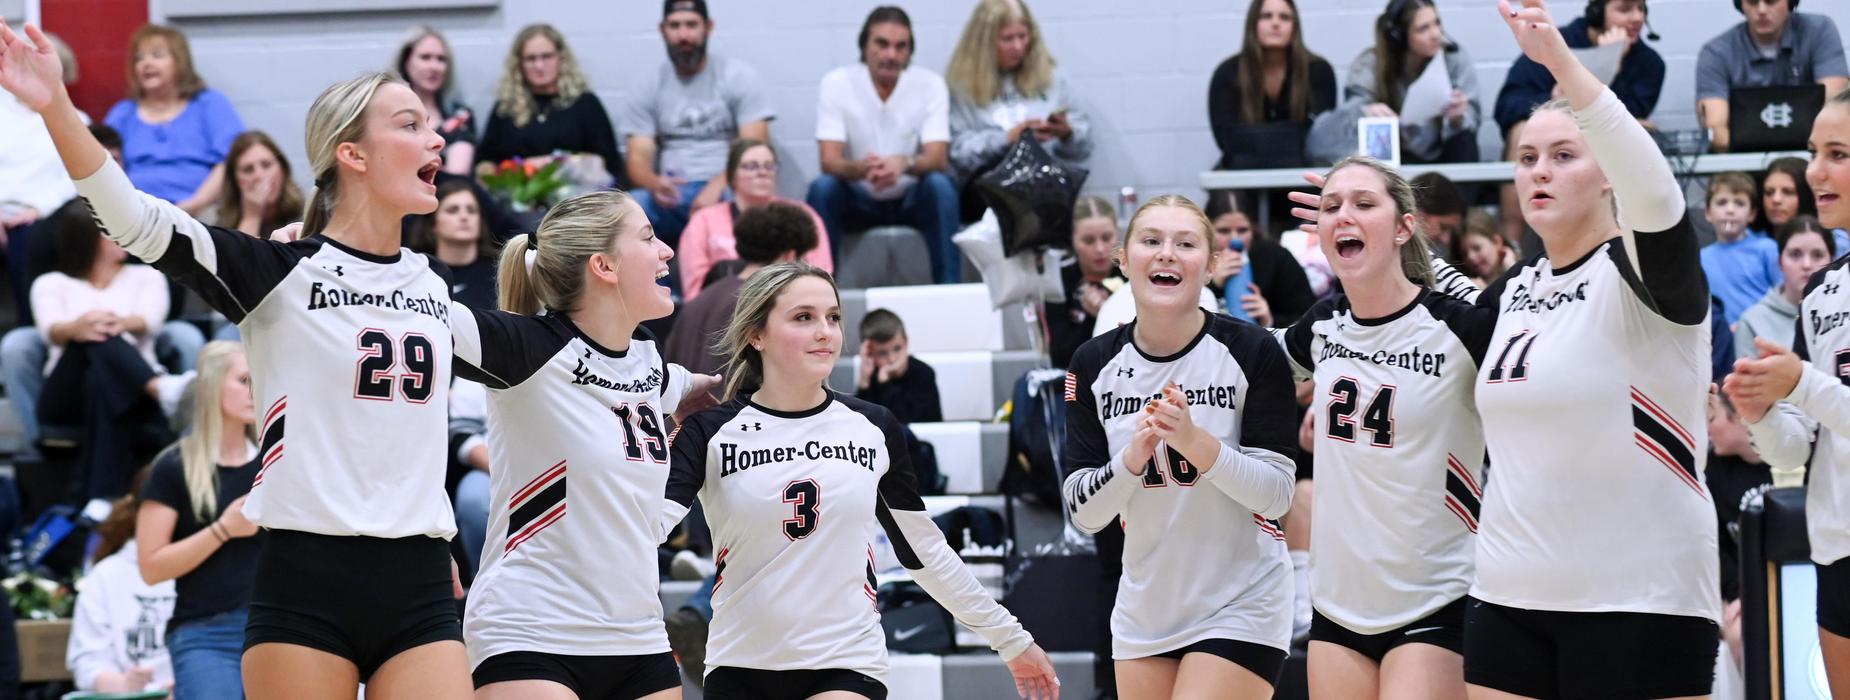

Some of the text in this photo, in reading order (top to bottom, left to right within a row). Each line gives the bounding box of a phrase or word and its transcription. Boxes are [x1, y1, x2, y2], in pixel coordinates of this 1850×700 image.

[353, 327, 438, 405] 29
[1486, 328, 1541, 384] 11
[611, 401, 668, 464] 19
[1101, 384, 1236, 420] Homerenter
[1326, 375, 1397, 448] 24
[720, 440, 876, 478] Homer-Center
[782, 478, 820, 541] 3
